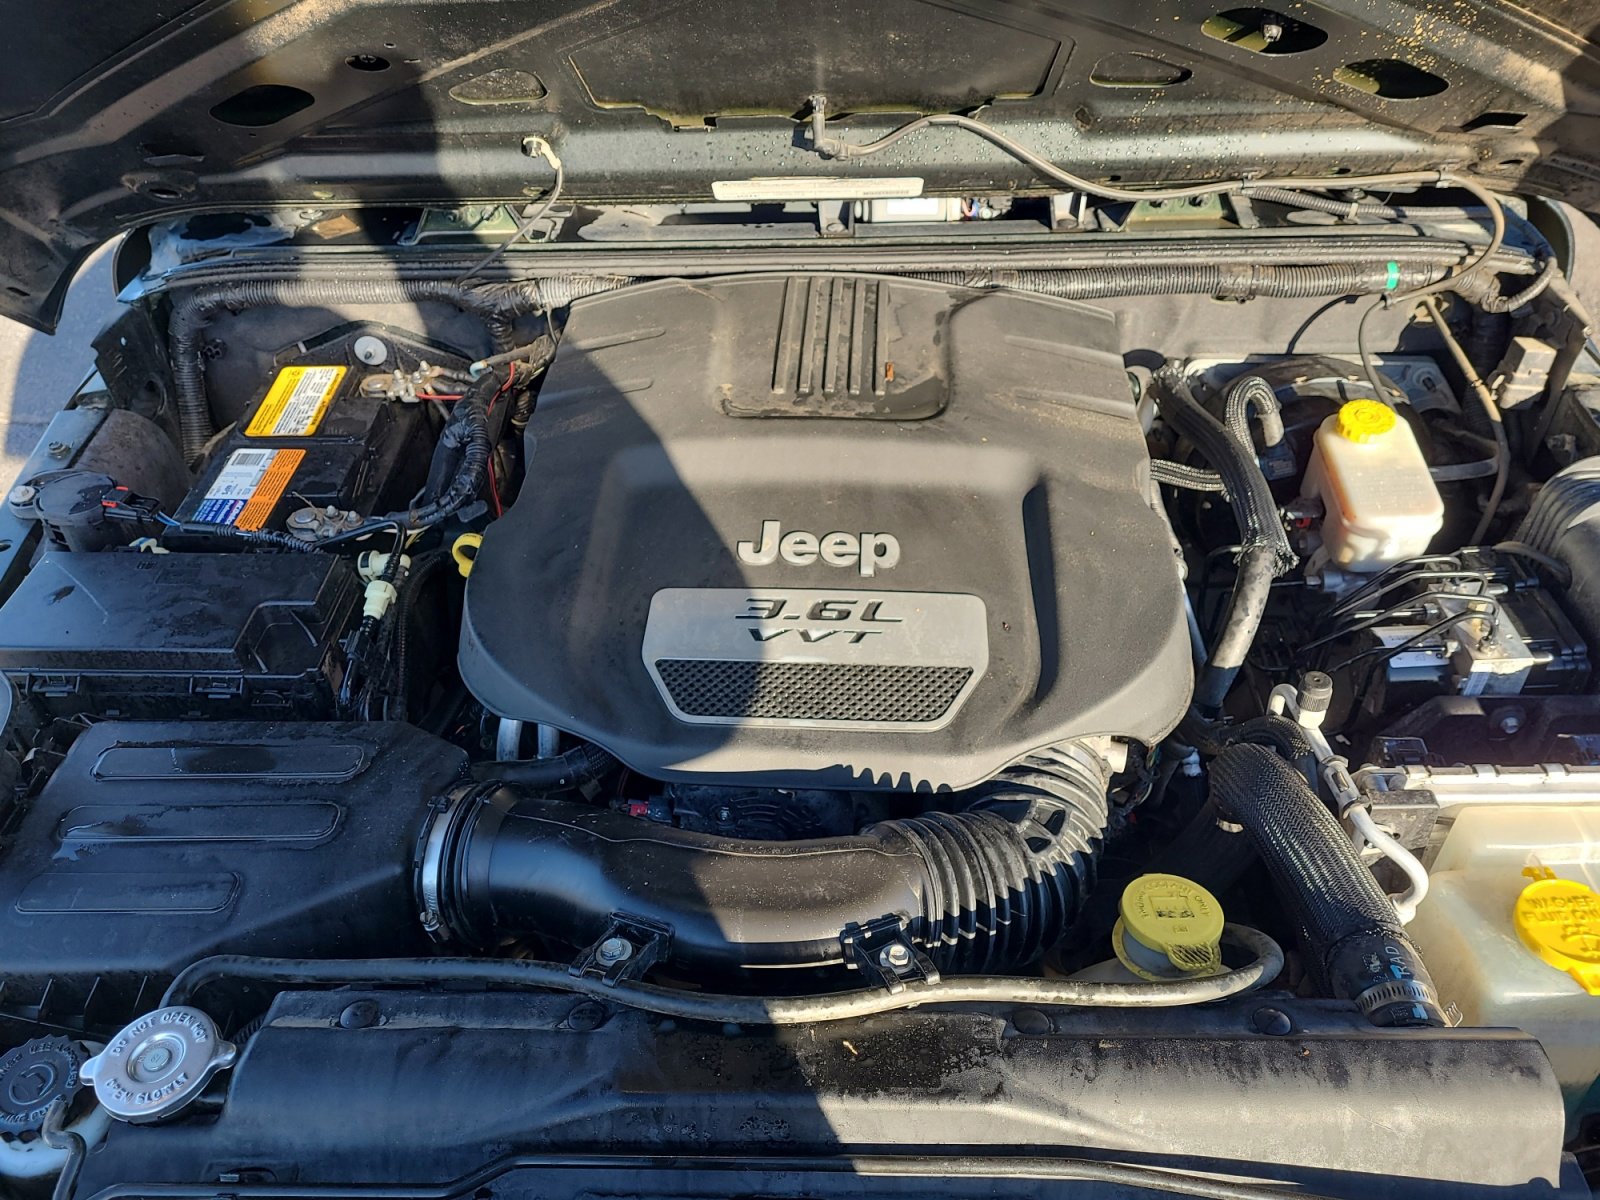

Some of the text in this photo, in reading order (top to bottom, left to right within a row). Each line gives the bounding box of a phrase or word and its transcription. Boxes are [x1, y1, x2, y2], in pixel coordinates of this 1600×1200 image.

[736, 519, 900, 577] Jeep
[735, 598, 903, 622] 3.6L
[748, 628, 882, 643] VVT
[1524, 895, 1594, 909] WASHER
[1521, 910, 1570, 922] FLUID
[1385, 946, 1411, 976] RAD
[112, 1011, 209, 1057] DO NOT OPEN HOT
[105, 1071, 190, 1105] OPEN SLOWLY
